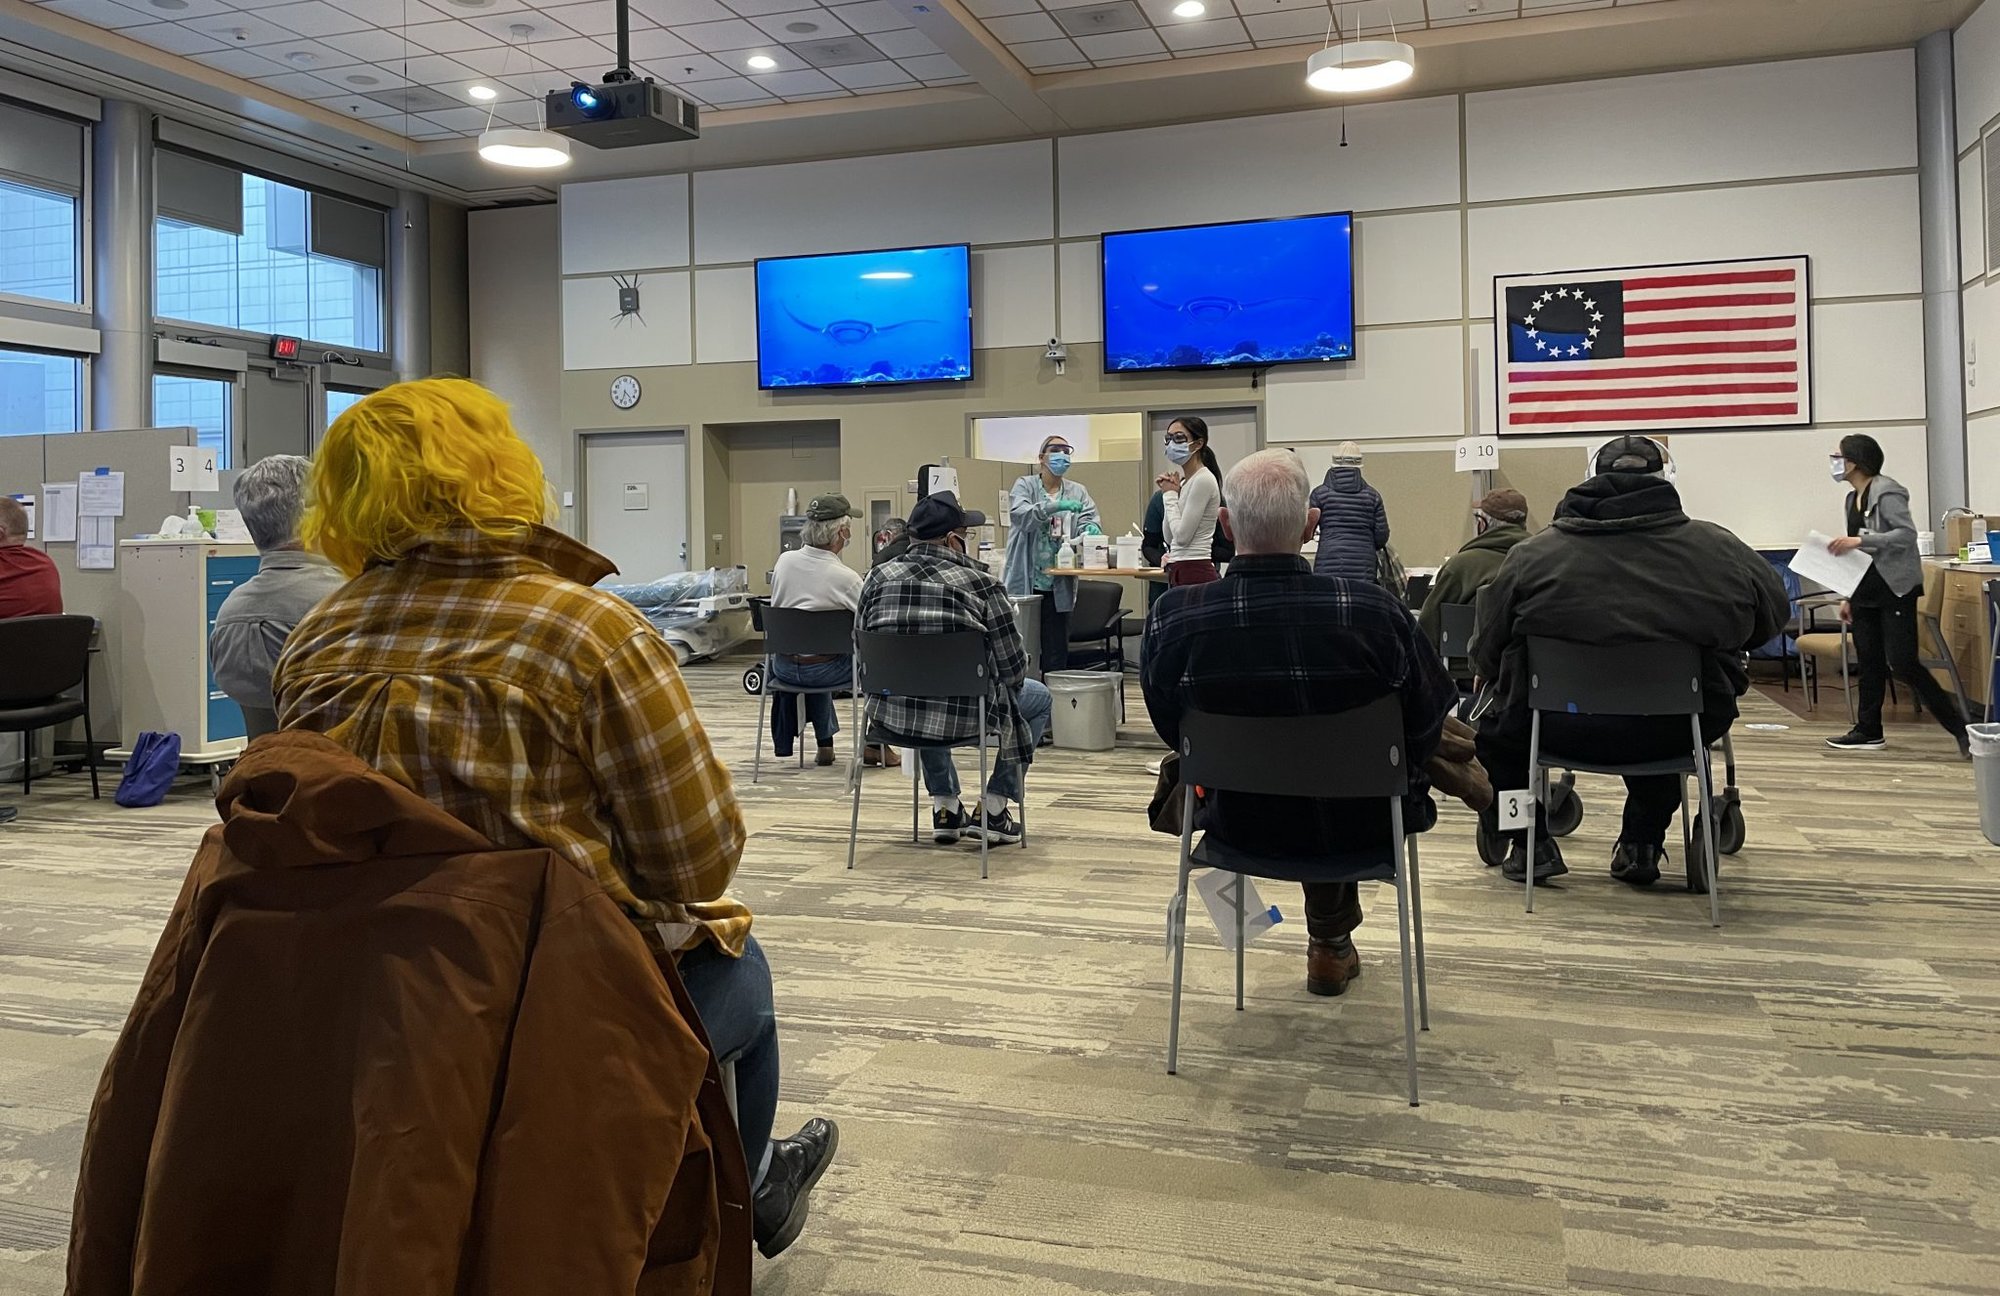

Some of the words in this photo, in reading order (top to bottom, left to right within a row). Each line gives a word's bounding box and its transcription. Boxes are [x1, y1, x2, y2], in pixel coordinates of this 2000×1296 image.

[1459, 446, 1467, 458] 9
[1477, 444, 1494, 457] 10
[176, 457, 185, 473] 3
[204, 458, 213, 473] 4
[932, 474, 940, 486] 7
[1509, 797, 1519, 818] 3
